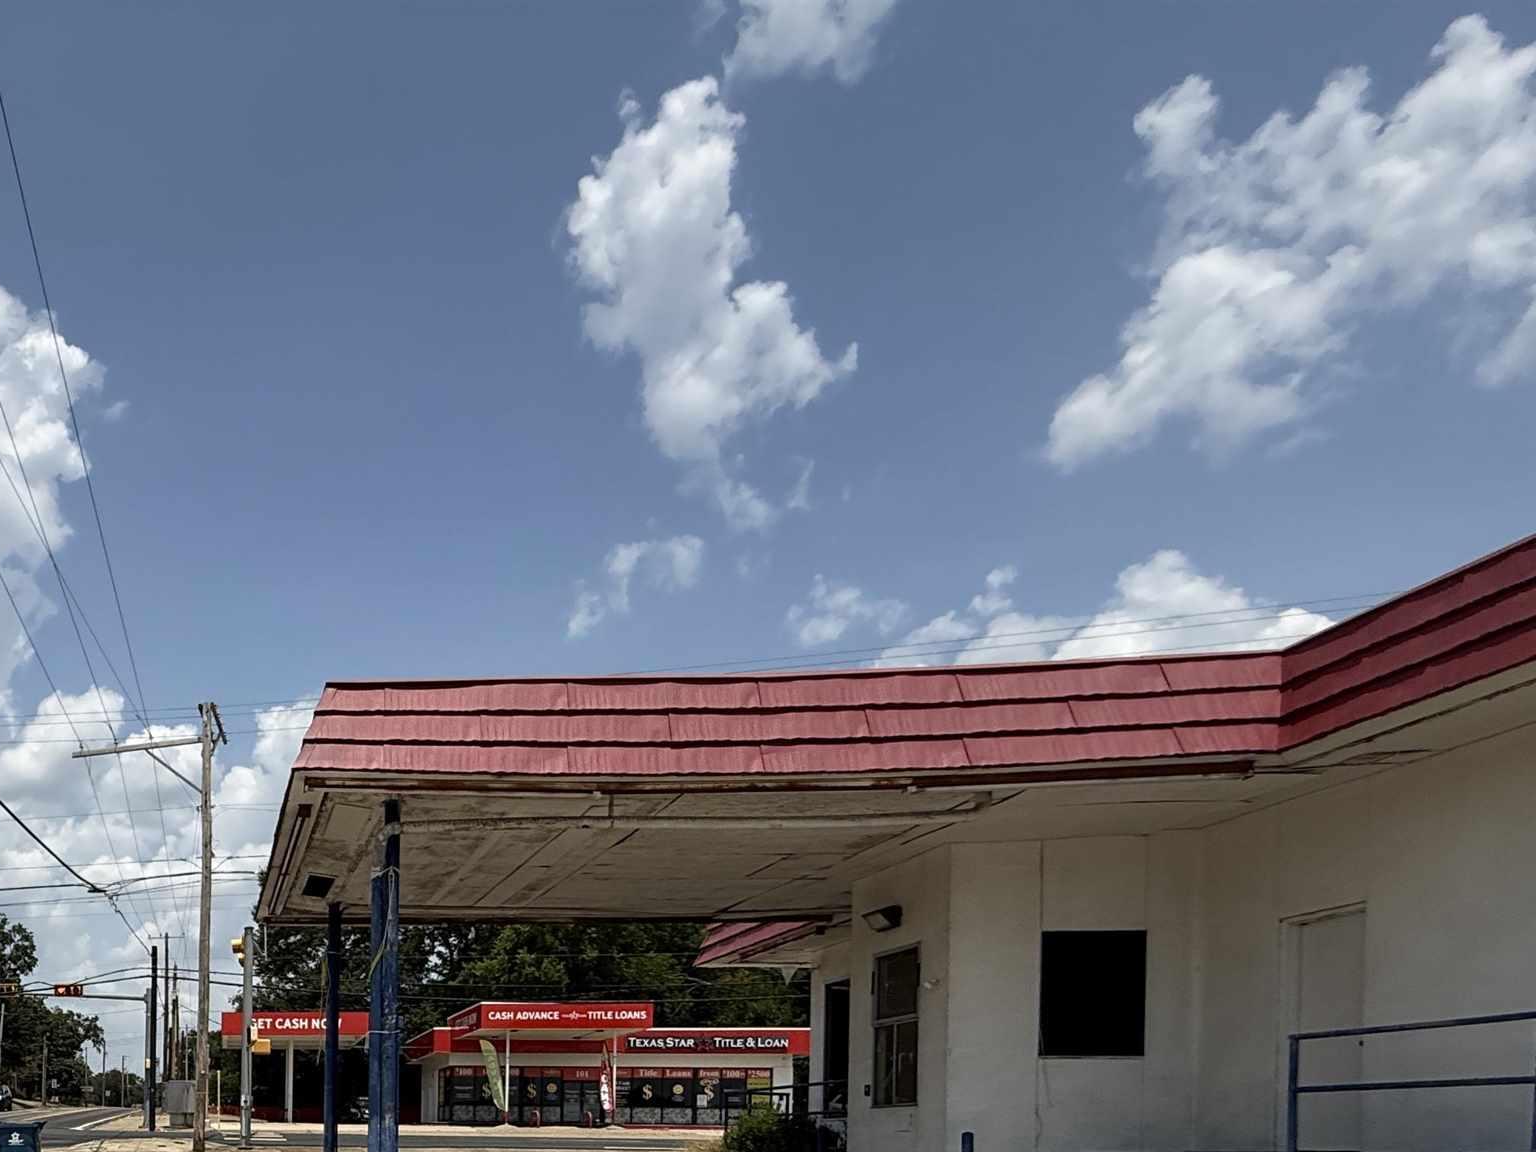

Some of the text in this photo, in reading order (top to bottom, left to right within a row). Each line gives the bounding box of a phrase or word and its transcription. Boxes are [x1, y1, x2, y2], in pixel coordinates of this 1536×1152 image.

[488, 1011, 514, 1020] CASH
[516, 1011, 560, 1020] ADVANCE
[587, 1011, 614, 1020] TITLE
[615, 1011, 647, 1020] LOANS
[275, 1018, 308, 1029] CASH
[311, 1018, 342, 1029] NO
[745, 1037, 755, 1048] &
